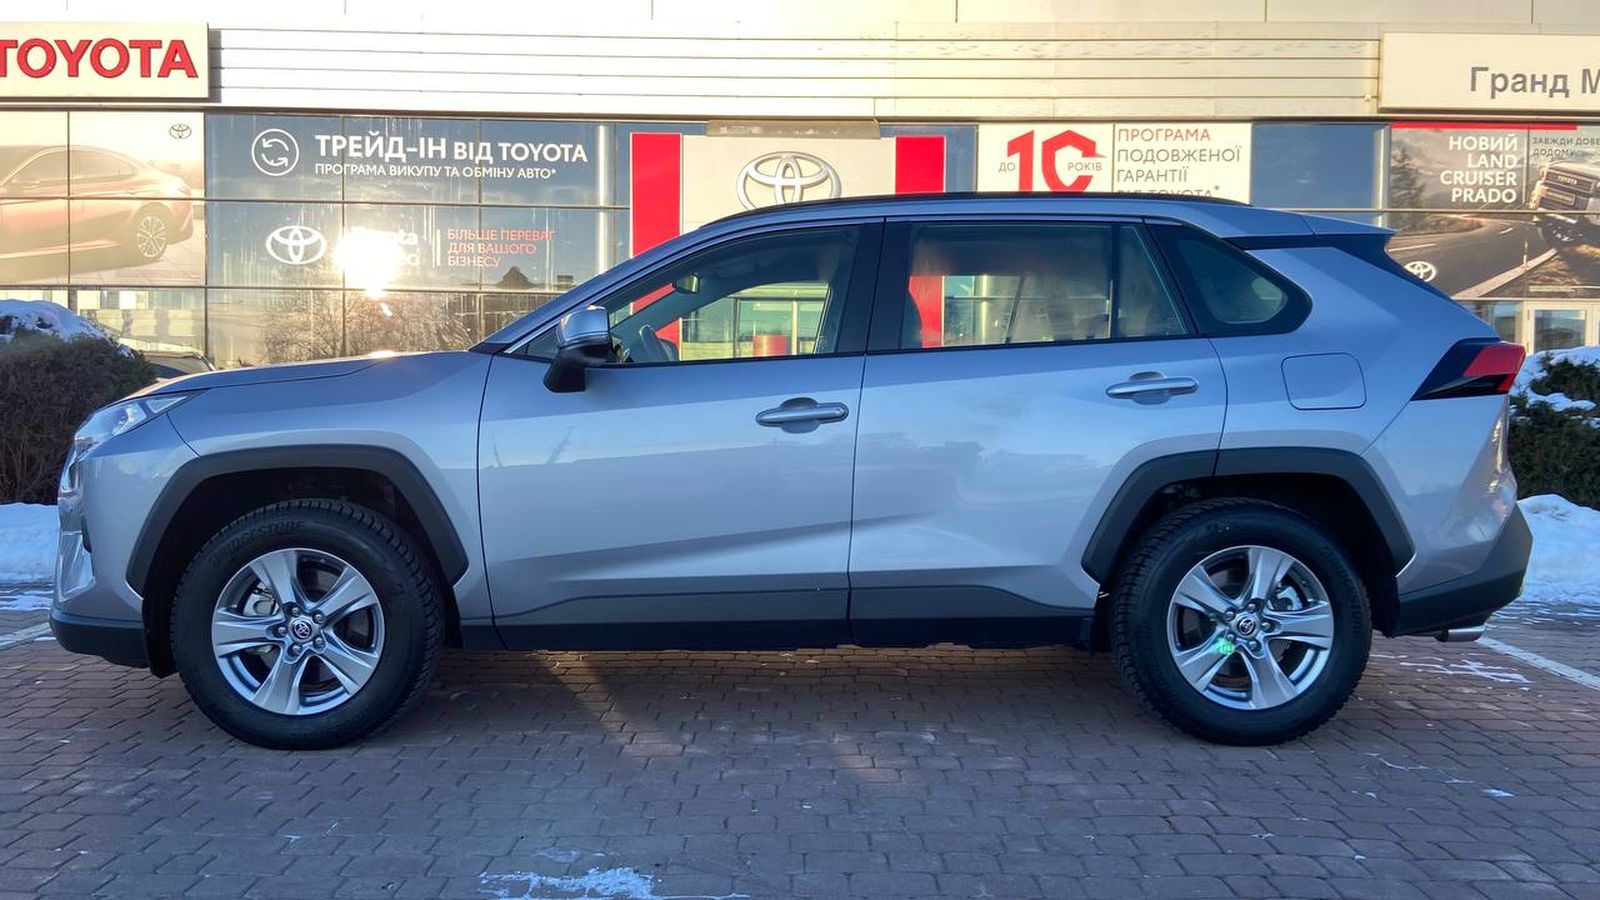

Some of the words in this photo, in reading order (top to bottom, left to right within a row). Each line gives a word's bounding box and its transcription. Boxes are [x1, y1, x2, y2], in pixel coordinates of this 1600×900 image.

[0, 38, 199, 79] TOYOTA
[1469, 66, 1570, 100] Гранд
[1118, 128, 1211, 142] ПРОГРАМА
[1449, 134, 1518, 151] НОВИЙ
[453, 141, 494, 164] ВІД
[498, 142, 589, 163] TOYOTA
[1117, 145, 1242, 164] ПОДОВЖЕНОЇ
[1467, 153, 1518, 168] LAND
[315, 163, 387, 176] ПРОГРАМА
[389, 165, 442, 177] ВИКУПУ
[444, 166, 460, 177] ТА
[462, 166, 515, 179] ОБМІНУ
[998, 161, 1016, 173] ДО
[1067, 162, 1103, 172] РОКІВ
[1117, 166, 1189, 182] ГАРАНТІЇ
[1440, 170, 1518, 186] CRUISER
[1451, 187, 1517, 204] PRADO
[447, 228, 498, 241] БІЛЬШЕ
[500, 228, 556, 241] ПЕРЕВАГ
[447, 243, 475, 255] ДЛЯ
[478, 243, 537, 255] ВАШОГО
[447, 256, 501, 268] БІЗНЕСУ
